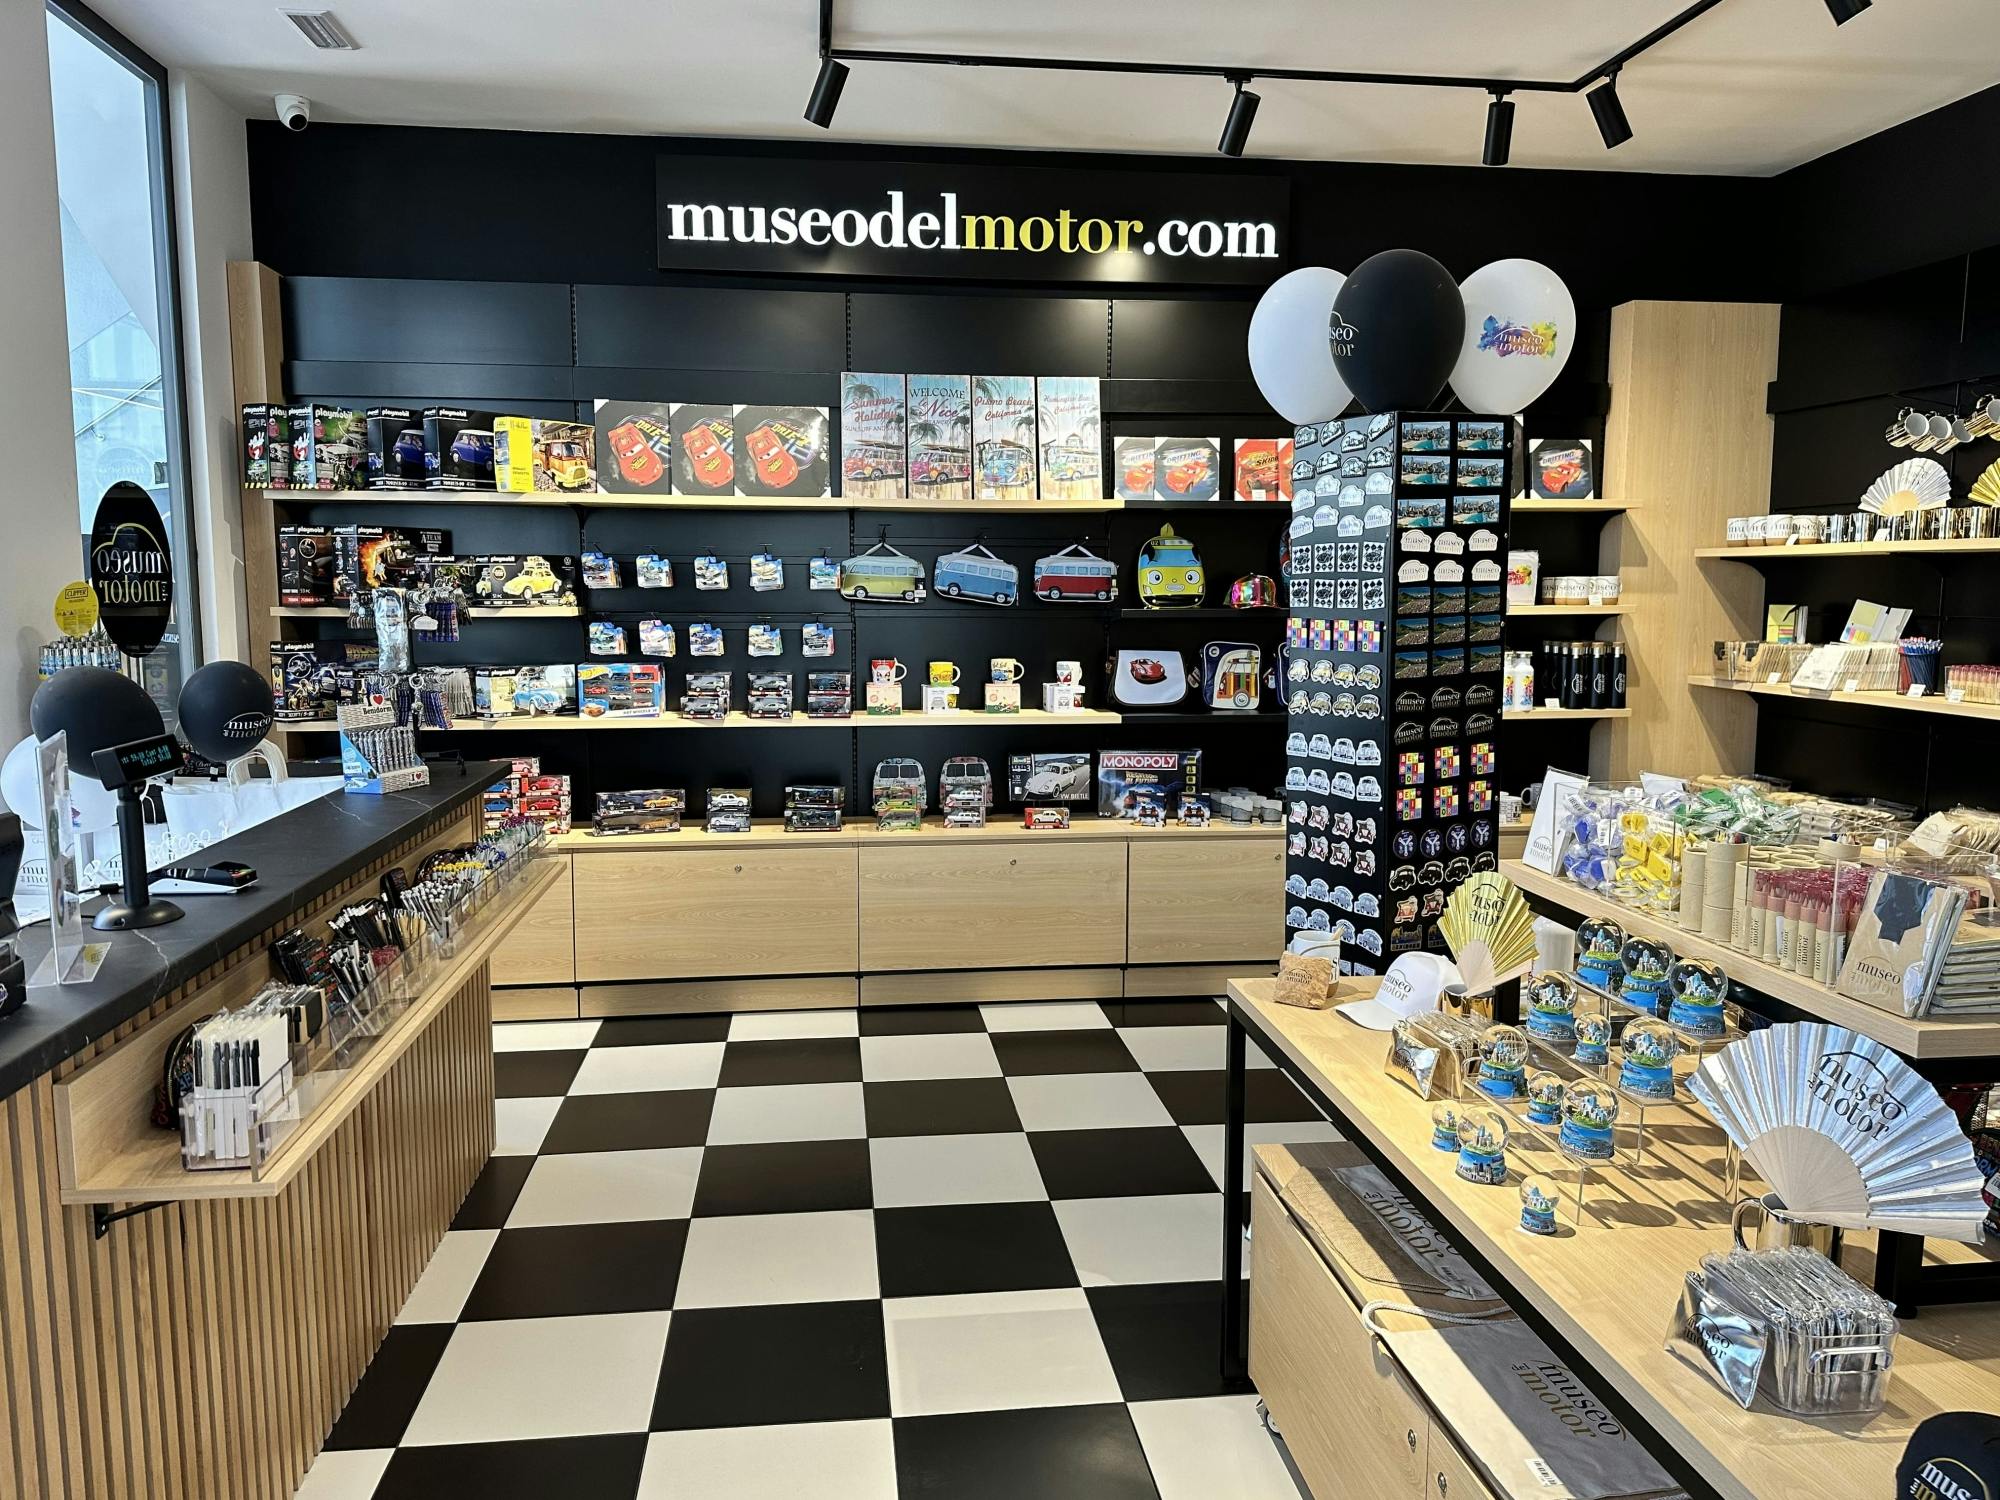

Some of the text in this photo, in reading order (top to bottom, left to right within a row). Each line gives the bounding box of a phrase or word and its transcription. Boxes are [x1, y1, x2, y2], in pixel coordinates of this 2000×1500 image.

[668, 191, 1279, 259] museodelmotor.com
[910, 388, 965, 399] WELCOME
[851, 397, 896, 410] Summer
[920, 399, 960, 417] Nice
[315, 408, 353, 419] playmobil
[381, 409, 410, 418] playmobil
[439, 409, 467, 418] playmobil
[855, 410, 898, 422] Holiday
[985, 409, 1022, 421] California
[297, 526, 325, 534] playmobil
[284, 643, 315, 651] playmobil
[1436, 694, 1460, 702] museo
[1470, 691, 1493, 699] museo
[362, 705, 393, 715] Benidorm
[228, 716, 271, 730] museo
[1434, 723, 1458, 732] museo
[1470, 719, 1493, 729] museo
[1399, 727, 1423, 737] museo
[1103, 757, 1176, 768] MONOPOLY
[1857, 960, 1901, 985] museo
[1820, 1057, 1902, 1121] museo
[1813, 1080, 1890, 1140] motor
[1370, 1199, 1445, 1258] motor
[1688, 1318, 1730, 1349] museo
[1685, 1326, 1727, 1359] motor
[1511, 1362, 1531, 1371] del
[1516, 1371, 1597, 1438] motor
[1536, 1364, 1621, 1436] museo
